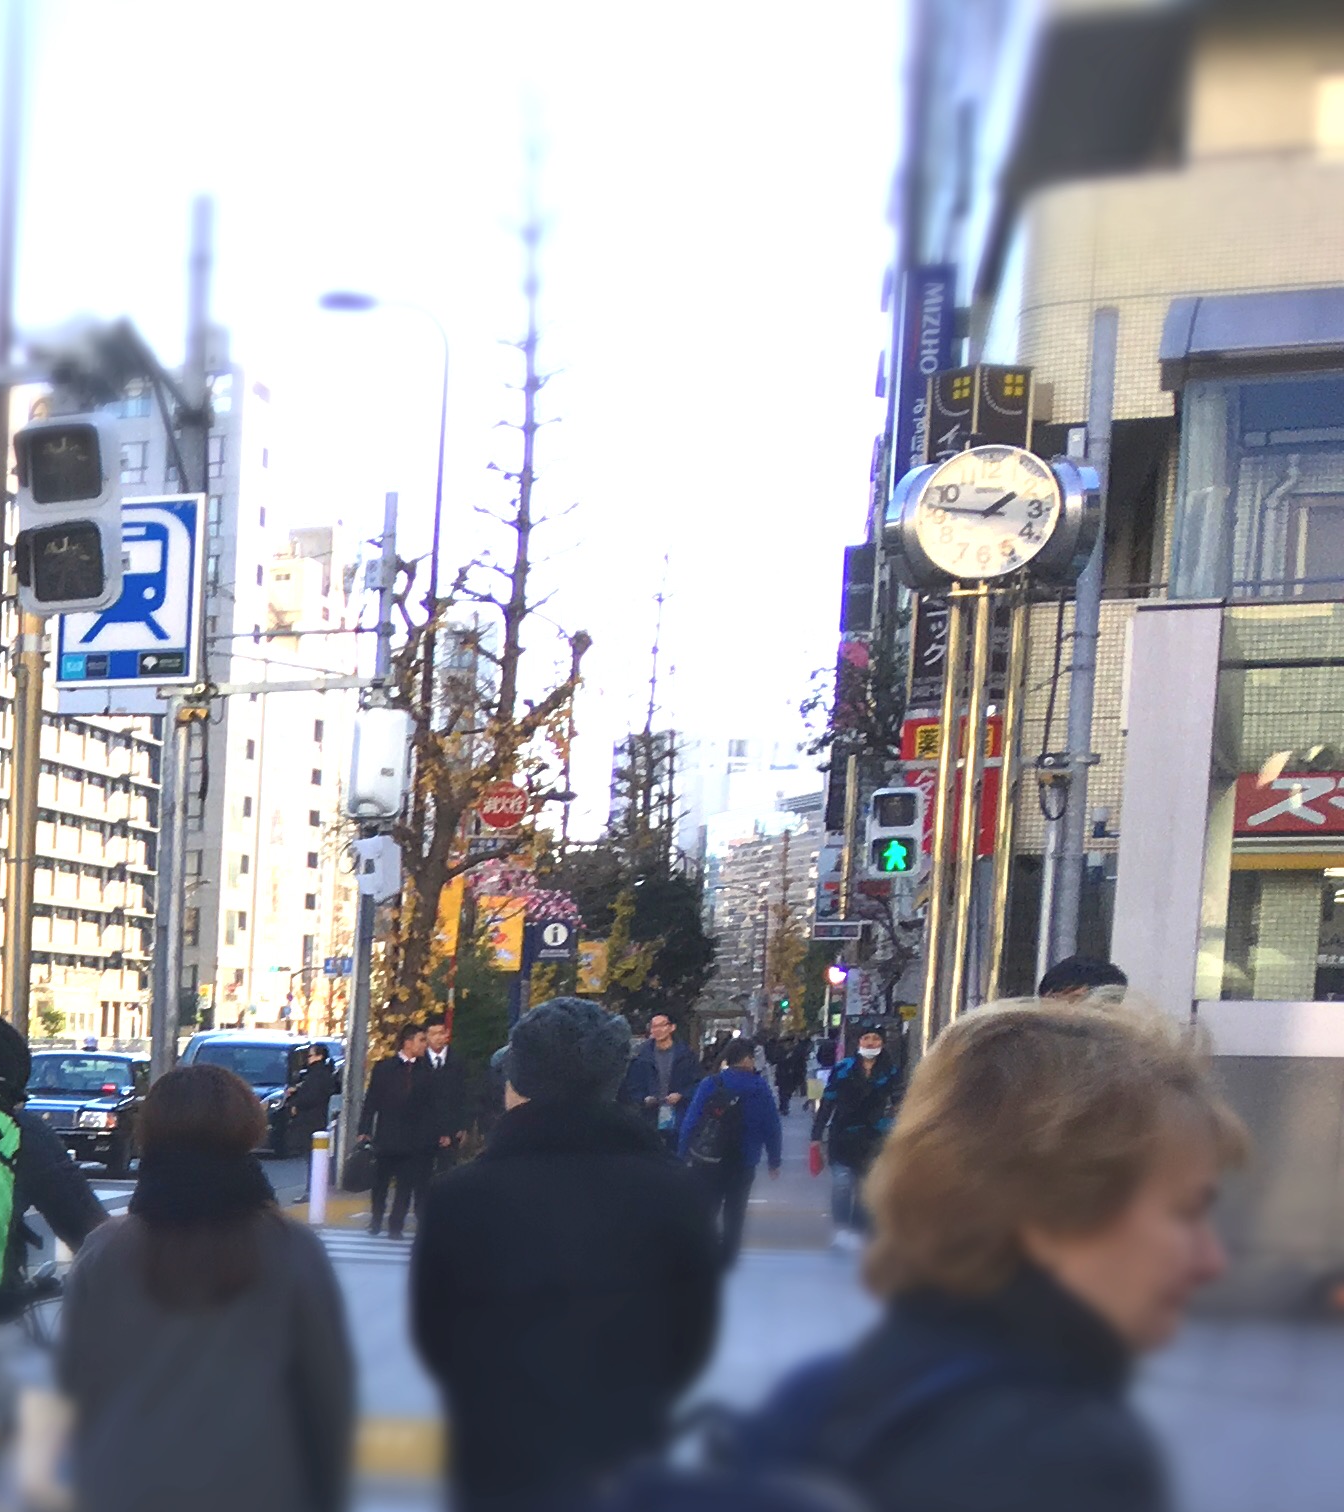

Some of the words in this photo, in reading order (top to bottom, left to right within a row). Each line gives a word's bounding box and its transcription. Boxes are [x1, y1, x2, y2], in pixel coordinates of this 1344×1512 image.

[920, 282, 944, 375] MIZUHO
[939, 484, 959, 503] 10
[1027, 499, 1043, 519] 3
[940, 527, 953, 544] 8
[1019, 522, 1034, 540] 4
[953, 543, 969, 564] 7
[977, 545, 991, 564] 6
